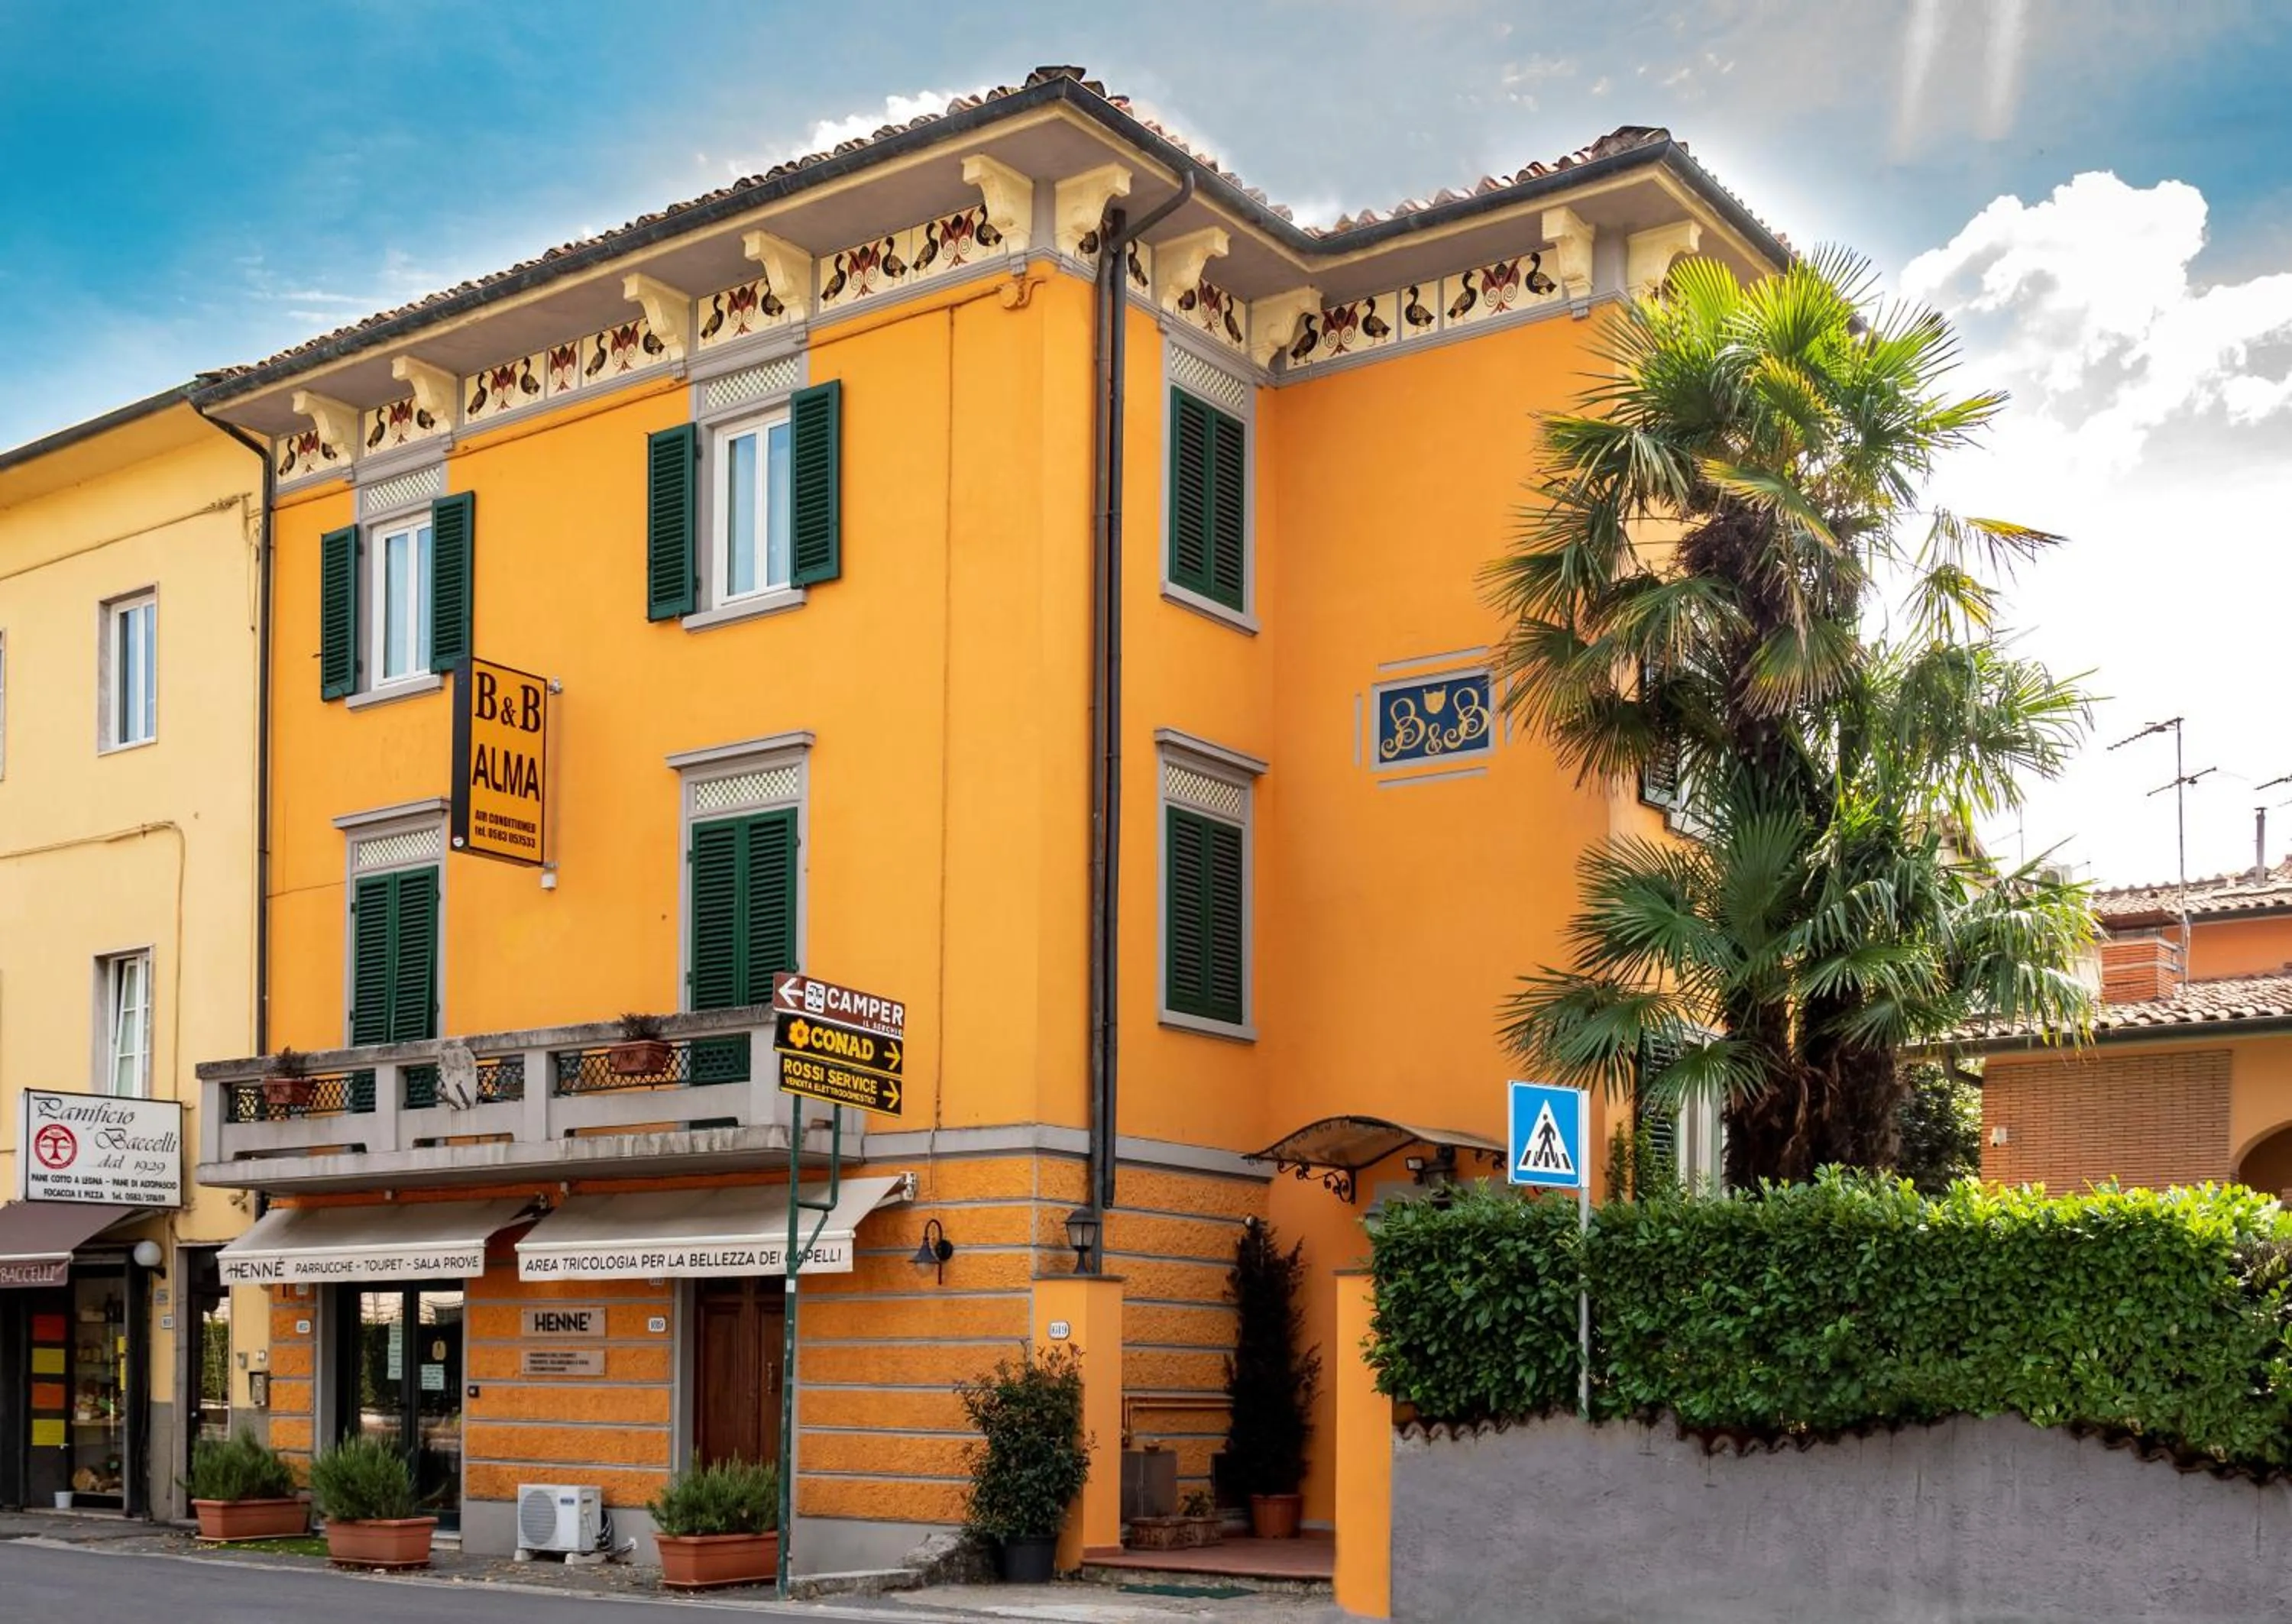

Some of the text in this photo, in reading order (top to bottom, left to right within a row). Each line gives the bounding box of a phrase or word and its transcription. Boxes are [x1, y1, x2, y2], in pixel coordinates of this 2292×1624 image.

[474, 671, 541, 733] B&B
[472, 743, 540, 802] ALMA
[827, 988, 904, 1026] CAMPER
[811, 1026, 875, 1061] CONAD
[783, 1058, 878, 1095] ROSSI SERVICE
[785, 1076, 812, 1089] VENDITA
[33, 1096, 135, 1131] Panificio
[95, 1127, 178, 1153] Baccelli
[97, 1153, 166, 1176] dal 1929
[50, 1174, 73, 1183] COTTO
[295, 1261, 353, 1273] PARRUCCHE
[364, 1258, 404, 1272] TOUPET
[413, 1258, 441, 1270] SALA
[444, 1255, 479, 1269] PROVE
[526, 1258, 558, 1272] AREA
[562, 1254, 638, 1270] TRICOLOGIA
[641, 1254, 665, 1268] PER
[668, 1254, 685, 1267] LA
[689, 1251, 756, 1267] BELLEZZA
[759, 1250, 781, 1265] DEI
[0, 1265, 55, 1283] BACCELLI
[535, 1312, 591, 1332] HENNE'
